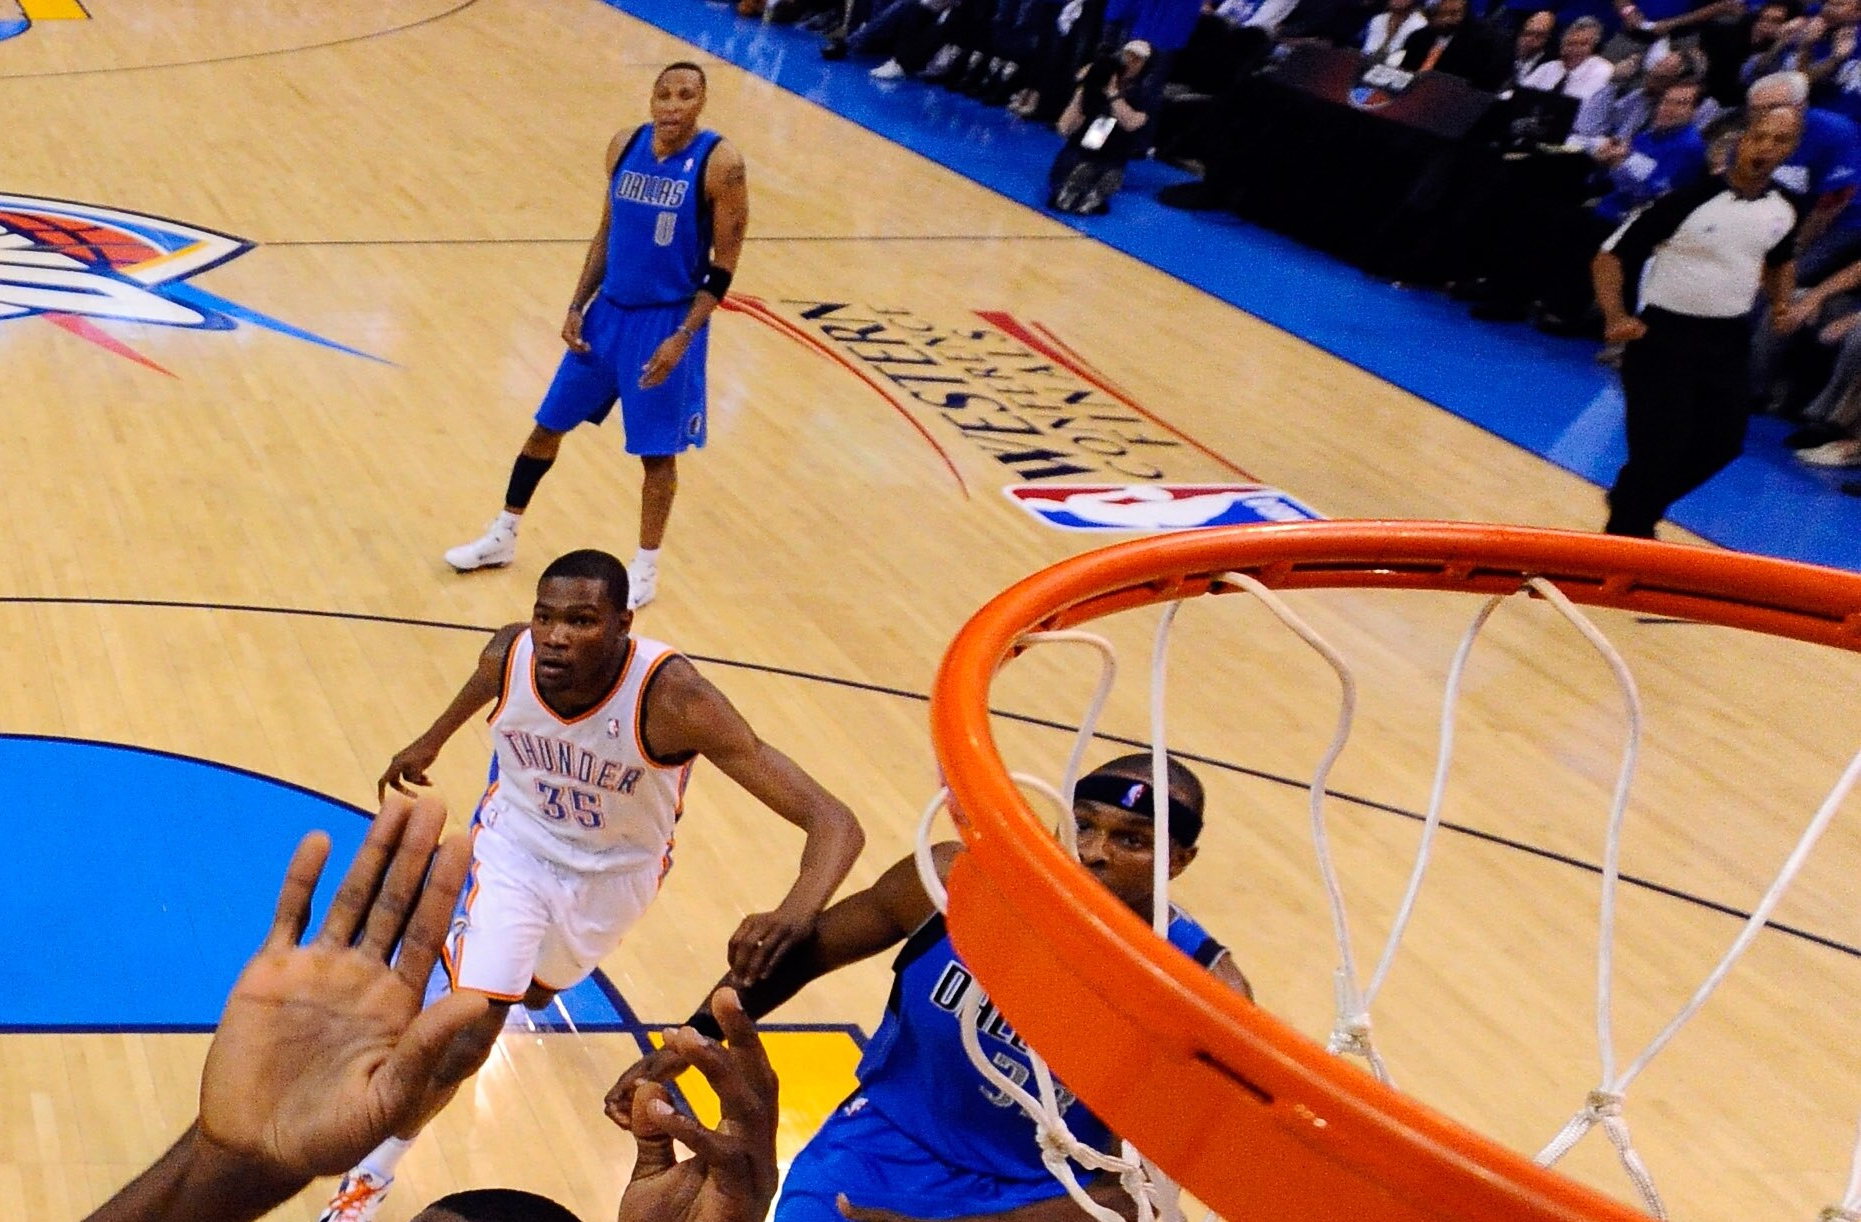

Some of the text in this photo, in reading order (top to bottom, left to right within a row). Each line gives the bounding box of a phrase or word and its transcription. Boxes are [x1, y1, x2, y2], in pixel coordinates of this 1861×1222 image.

[615, 169, 690, 209] DALLAS
[779, 299, 1097, 482] WESTERN
[866, 303, 1163, 480] CONFERENCE
[950, 328, 1185, 448] FINALS
[500, 729, 646, 797] THUNDER
[534, 778, 606, 830] 35
